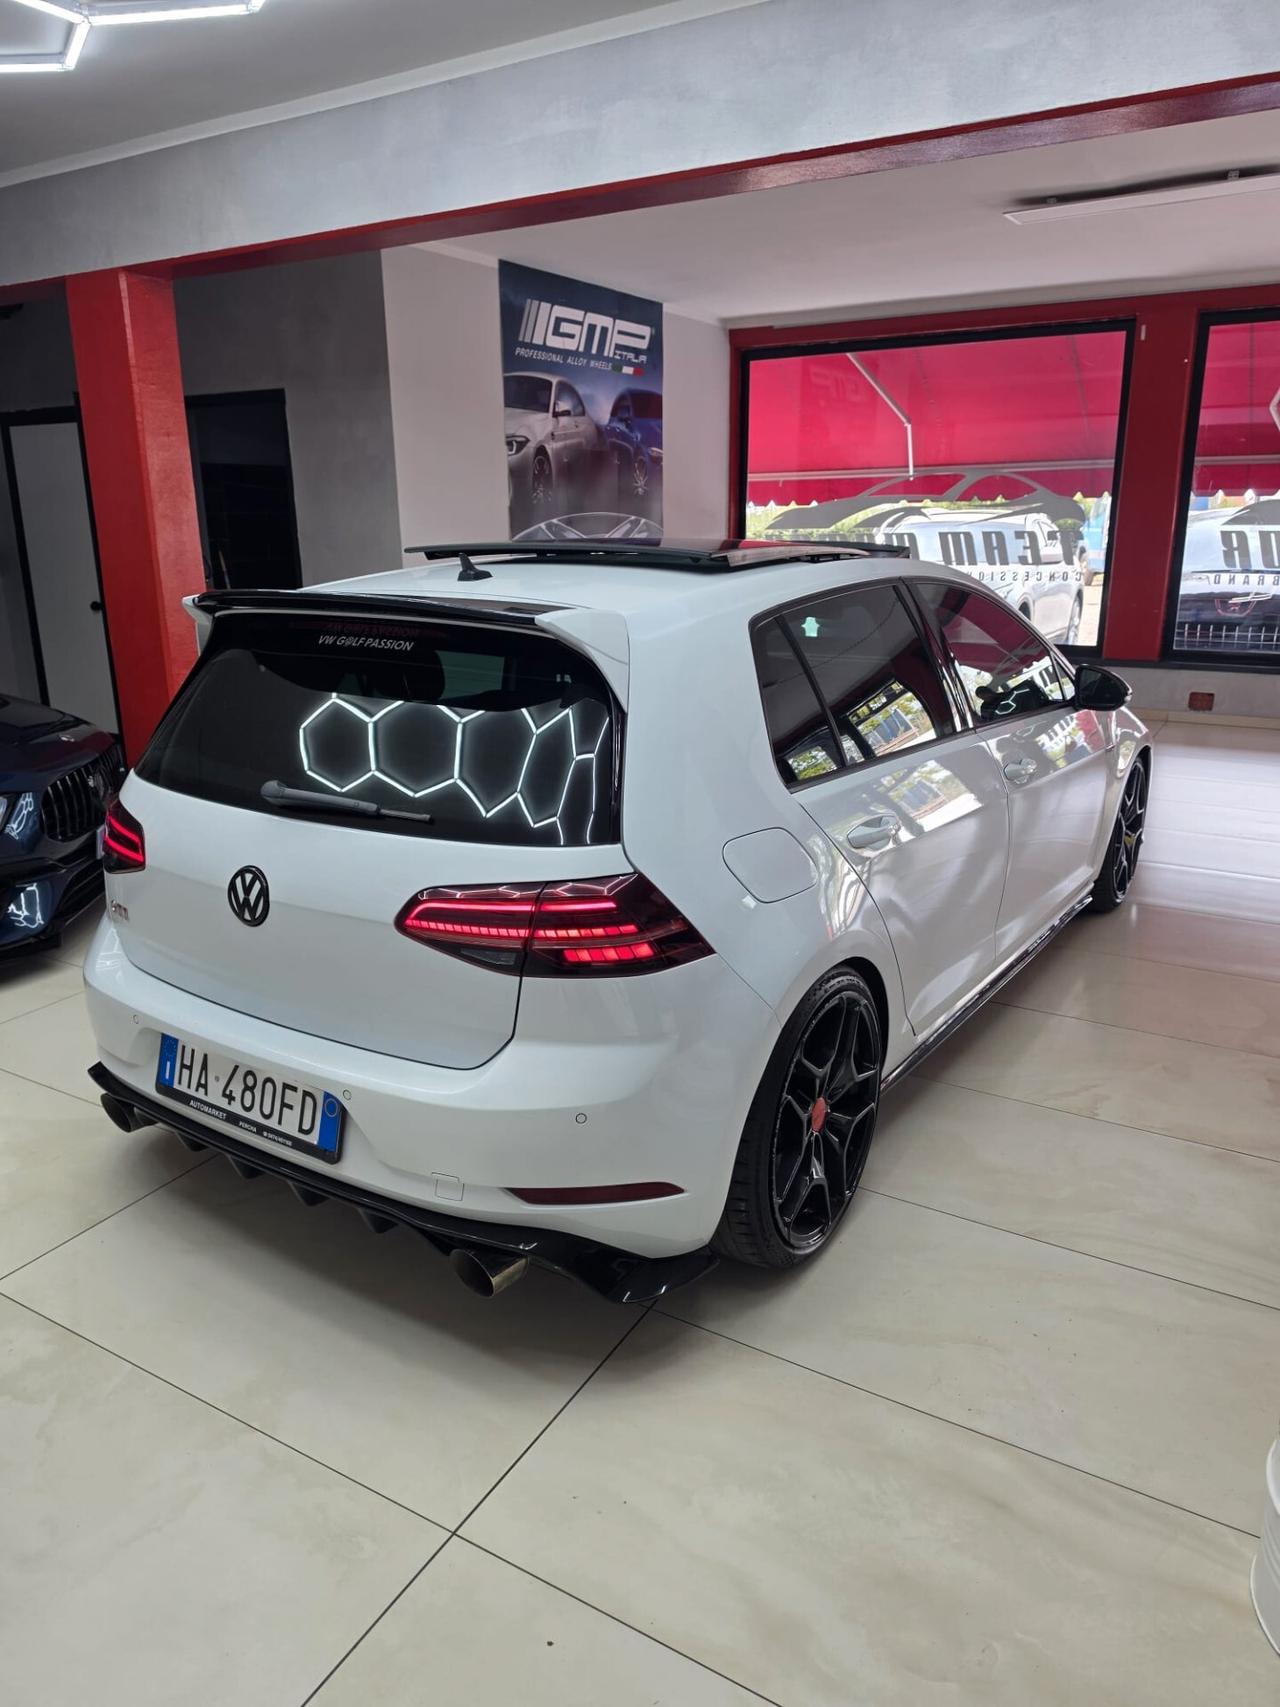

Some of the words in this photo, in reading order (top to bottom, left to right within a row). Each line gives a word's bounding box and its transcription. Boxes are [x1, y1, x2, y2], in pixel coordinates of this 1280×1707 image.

[546, 304, 652, 358] GMP
[515, 347, 564, 363] PROFESSIONAL
[566, 354, 588, 367] ALLOY
[319, 635, 337, 645] VW
[364, 638, 414, 652] PASSION
[178, 1044, 209, 1097] HA
[221, 1064, 318, 1136] 480FD
[189, 1099, 227, 1121] AUTOMARKET
